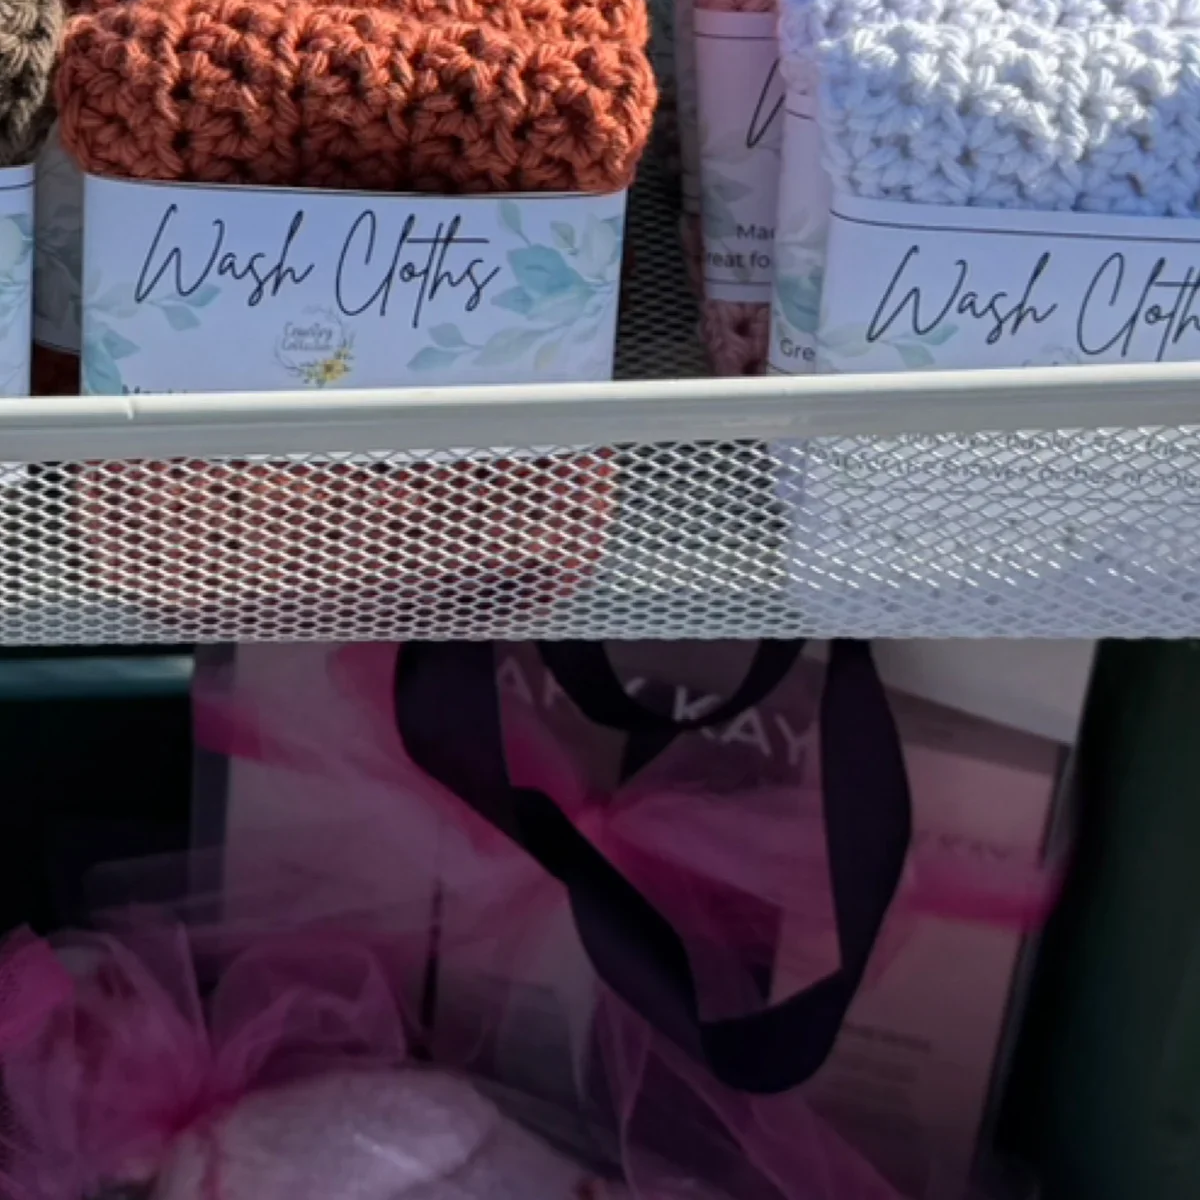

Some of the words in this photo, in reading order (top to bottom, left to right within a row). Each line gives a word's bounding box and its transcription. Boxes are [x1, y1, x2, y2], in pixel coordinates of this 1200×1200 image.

[135, 203, 315, 307] Wash
[335, 209, 501, 328] Cloths
[707, 253, 745, 269] reat
[751, 253, 771, 269] fo
[865, 244, 1059, 345] Wash
[1076, 251, 1200, 362] Cloth
[779, 338, 817, 363] Gre
